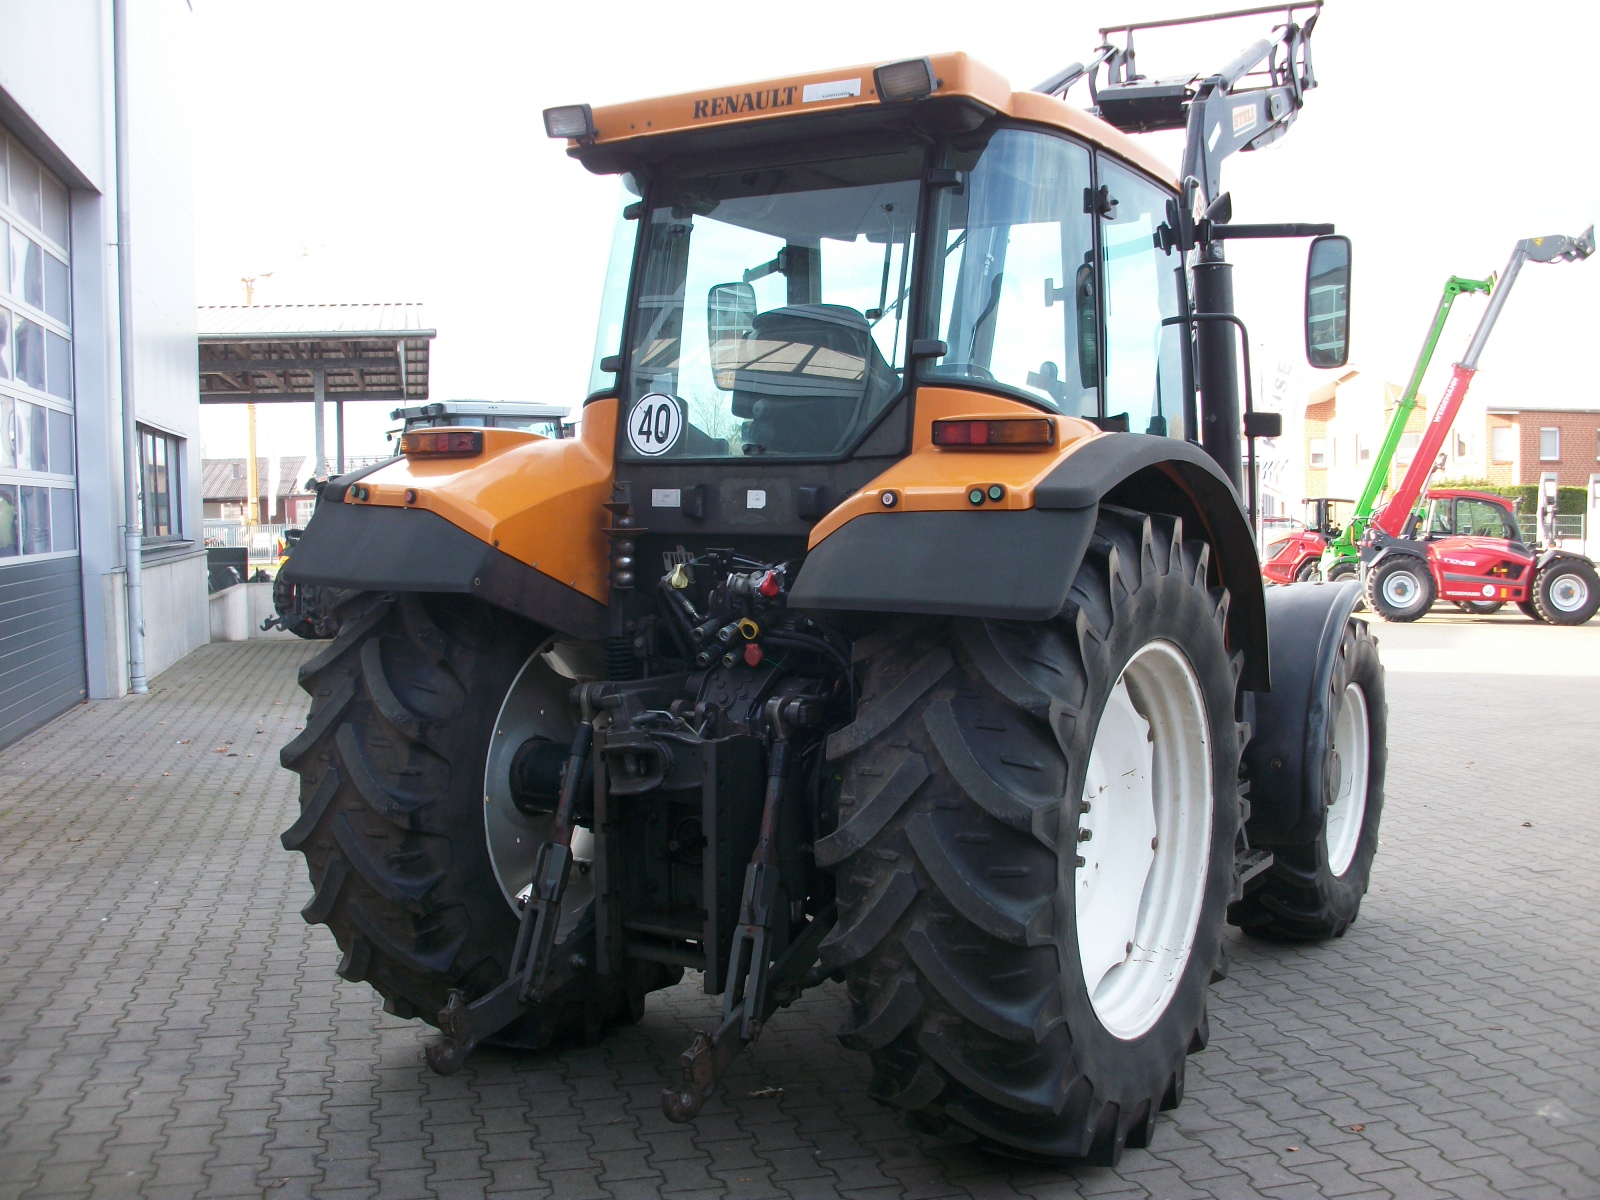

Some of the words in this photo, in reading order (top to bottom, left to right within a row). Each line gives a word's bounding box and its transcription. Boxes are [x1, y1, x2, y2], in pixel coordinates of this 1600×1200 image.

[693, 86, 797, 119] RENAULT
[1432, 377, 1459, 423] WEIDEMANN
[637, 403, 671, 445] 40
